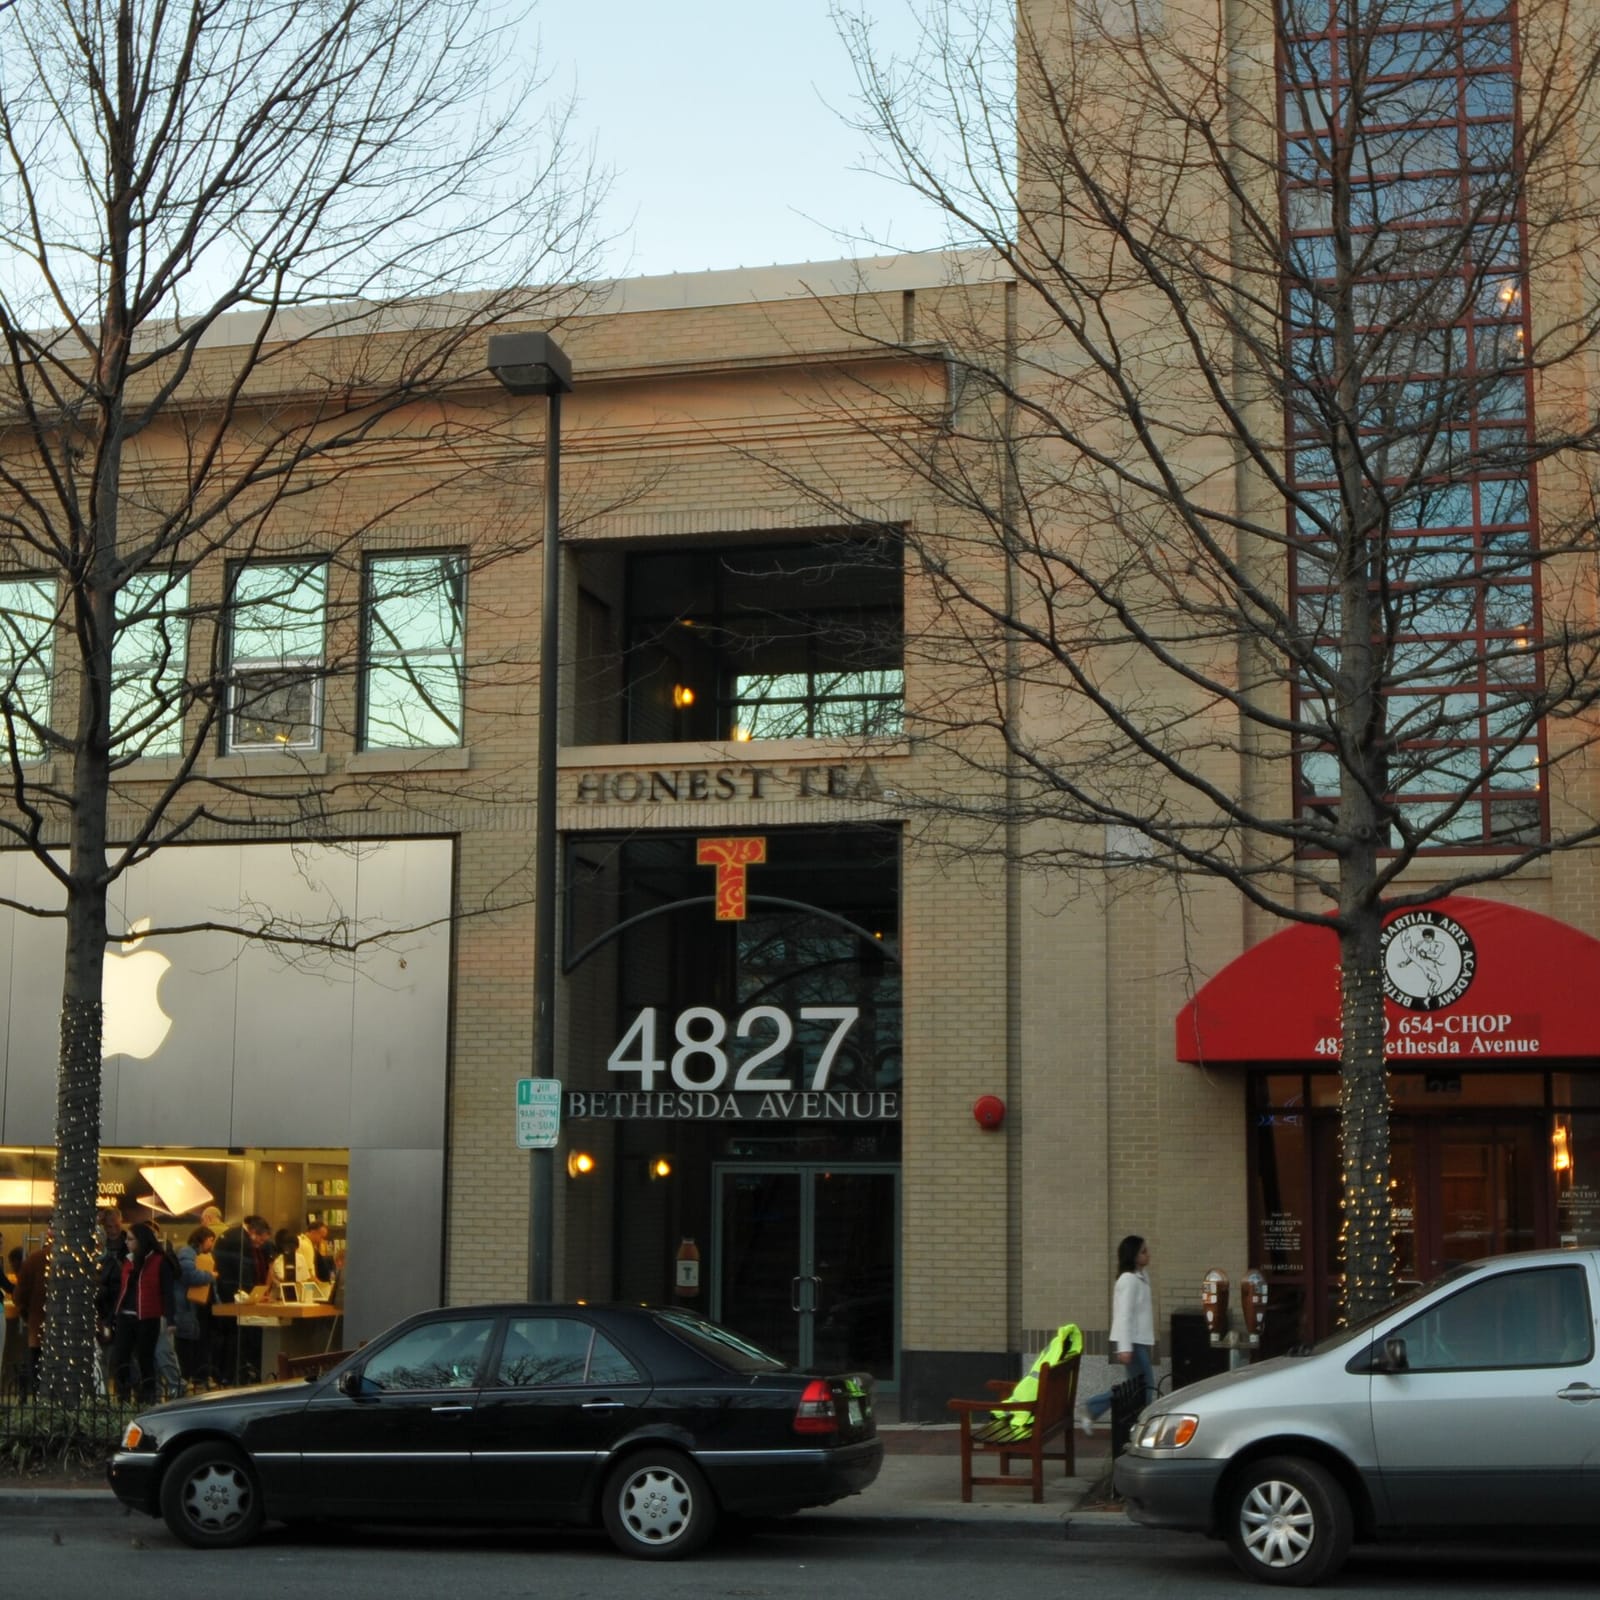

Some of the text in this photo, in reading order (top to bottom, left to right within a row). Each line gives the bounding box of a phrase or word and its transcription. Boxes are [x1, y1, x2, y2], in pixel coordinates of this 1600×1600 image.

[576, 763, 887, 804] HONEST TEA
[696, 836, 767, 921] T
[1380, 912, 1434, 945] MARTIAL
[1438, 917, 1469, 945] ARTS
[1438, 950, 1475, 1008] ACADEMY
[1399, 1014, 1512, 1034] 654-CHOP
[606, 1005, 860, 1092] 4827
[1384, 1037, 1461, 1055] ethesda
[1470, 1036, 1540, 1054] Avenue
[568, 1091, 898, 1119] BETHESDA AVENUE
